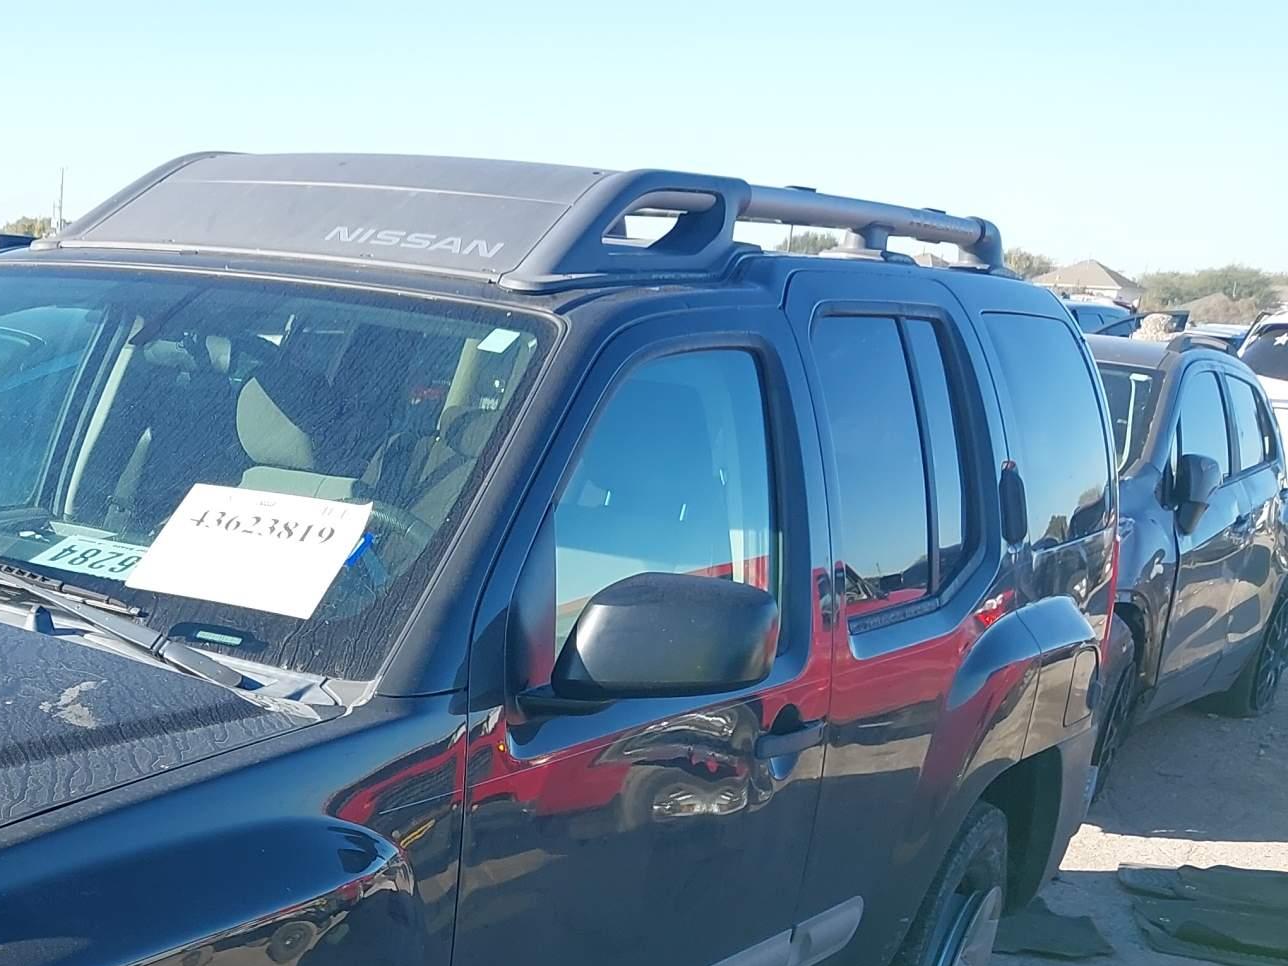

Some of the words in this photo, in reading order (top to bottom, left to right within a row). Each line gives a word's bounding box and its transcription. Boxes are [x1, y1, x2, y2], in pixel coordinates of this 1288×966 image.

[324, 225, 505, 259] NISSAN
[190, 509, 336, 544] 43623819
[48, 543, 143, 574] 6284
